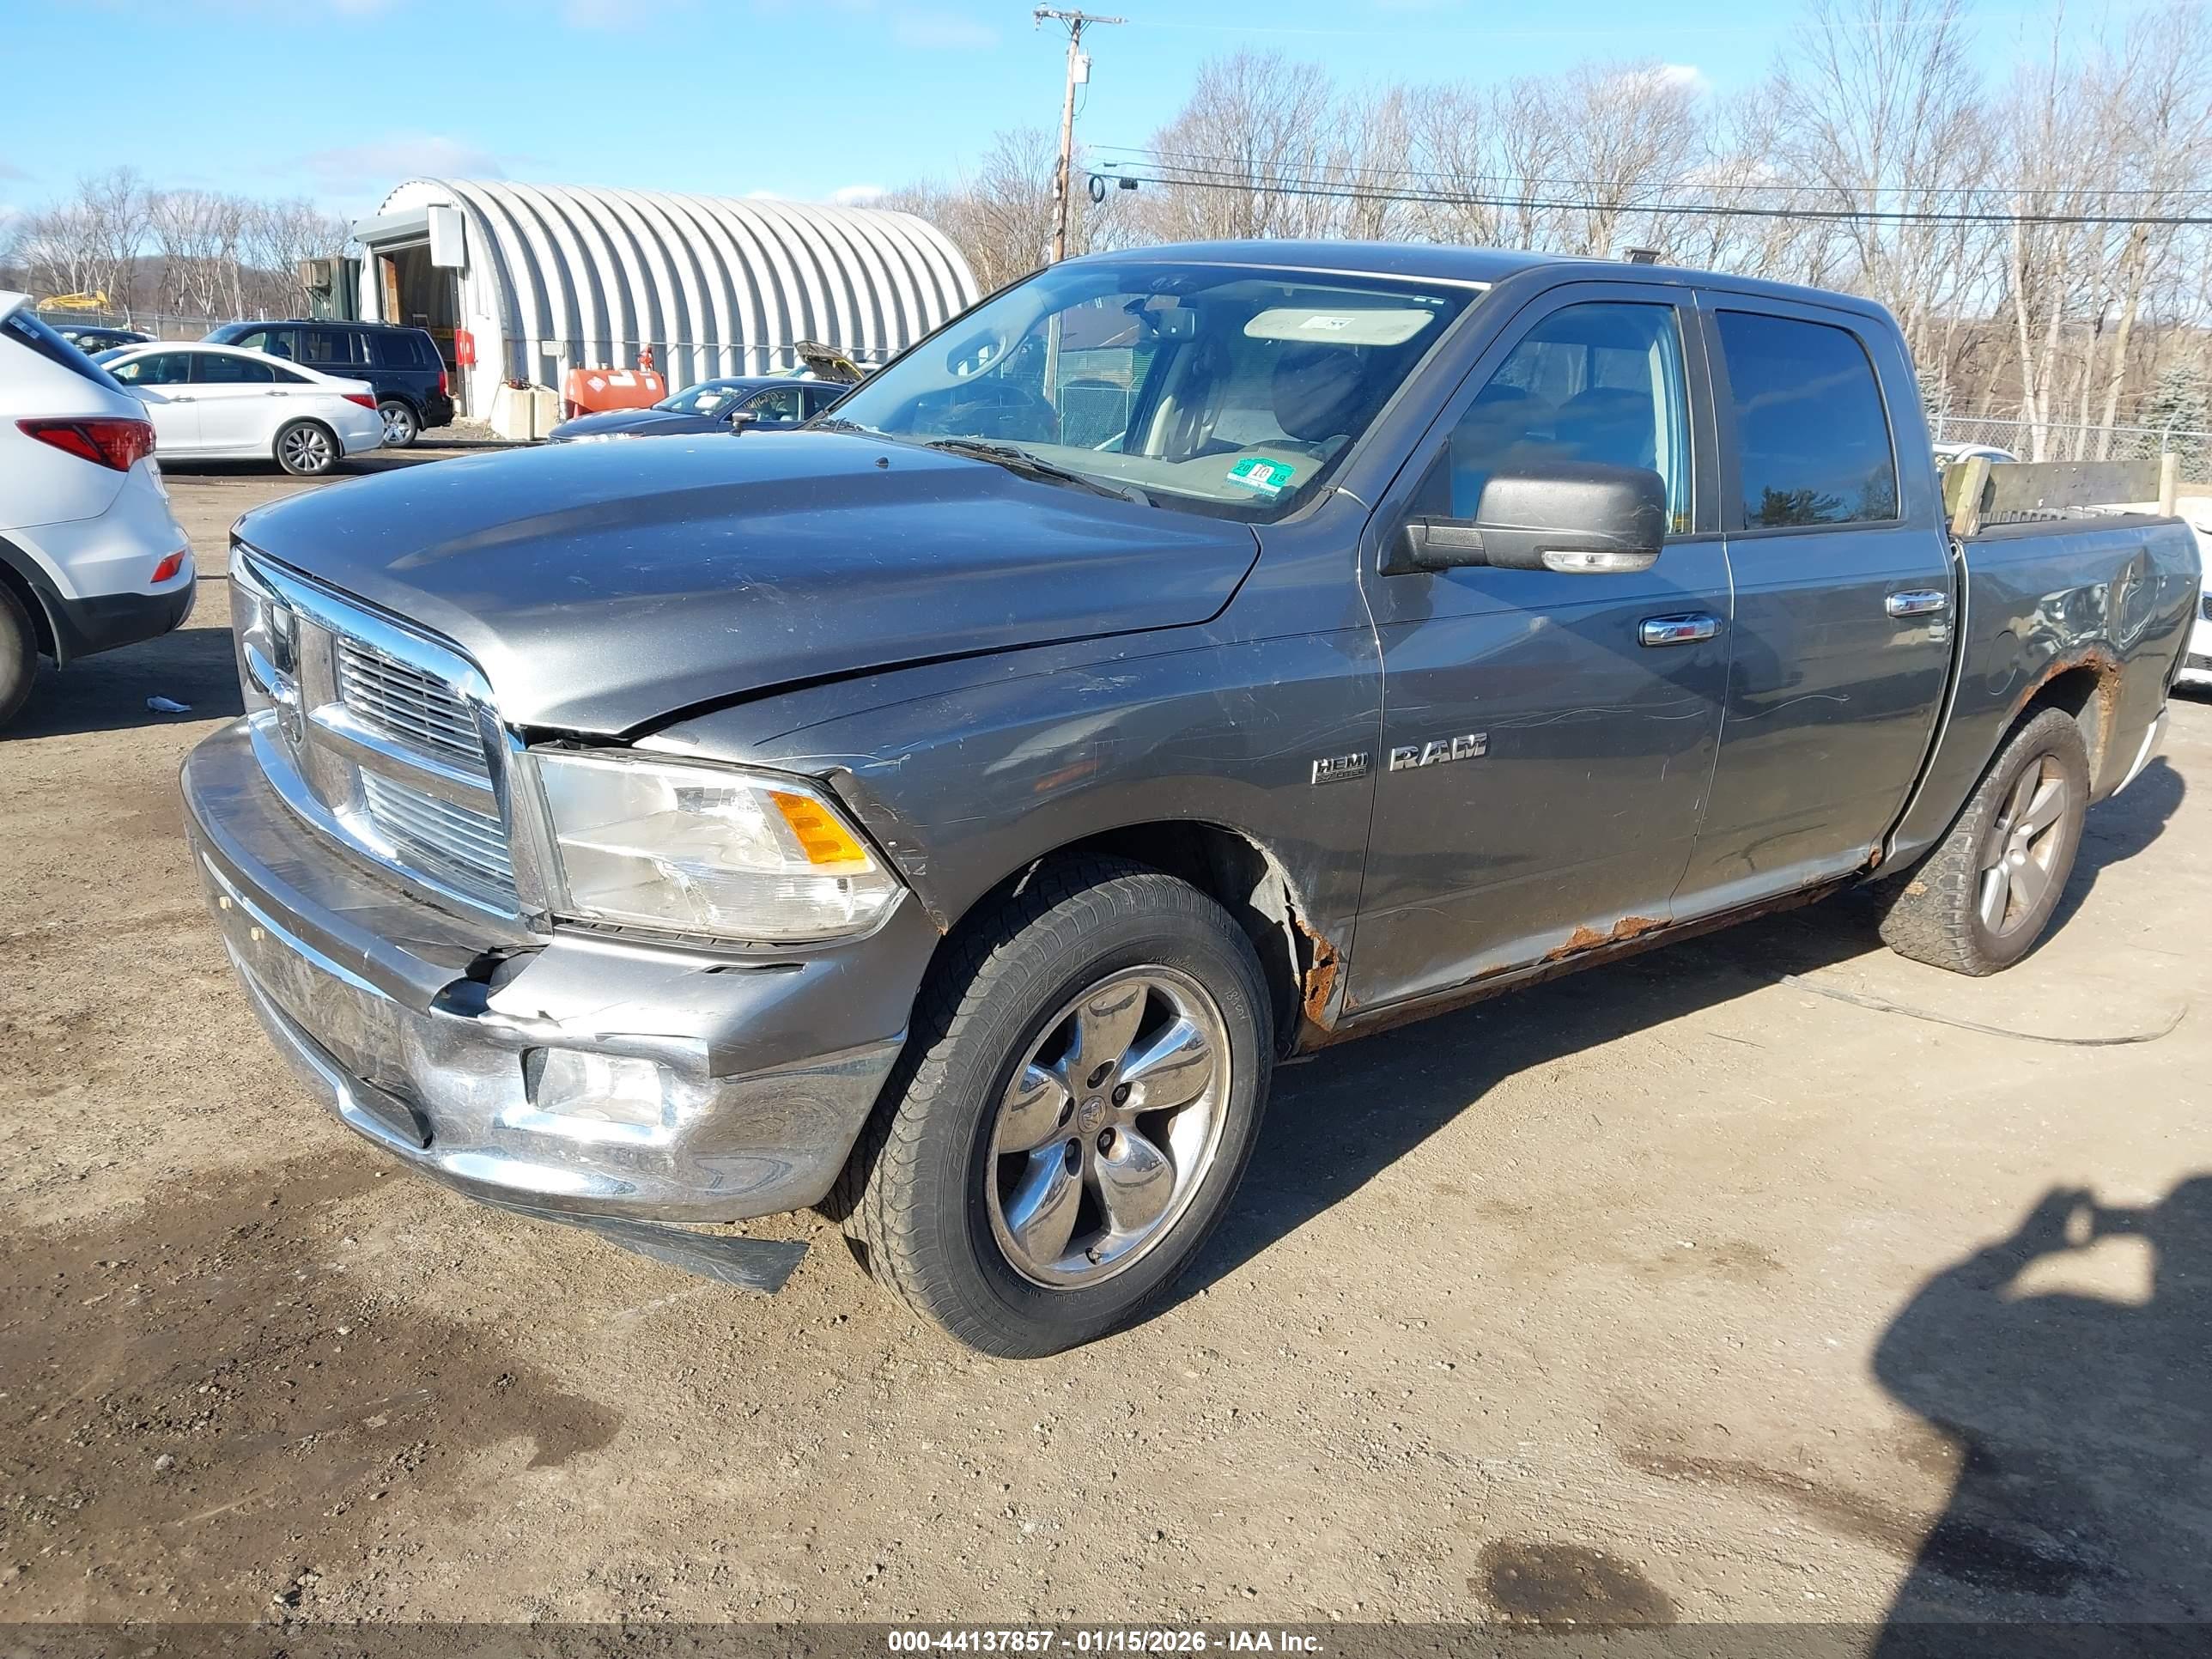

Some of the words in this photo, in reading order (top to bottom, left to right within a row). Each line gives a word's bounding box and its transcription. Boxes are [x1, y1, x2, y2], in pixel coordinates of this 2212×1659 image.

[1237, 463, 1251, 471] 20
[1252, 465, 1270, 478] 10
[1273, 473, 1286, 482] 19
[1312, 751, 1369, 778] HEMI
[1389, 732, 1489, 772] RAM
